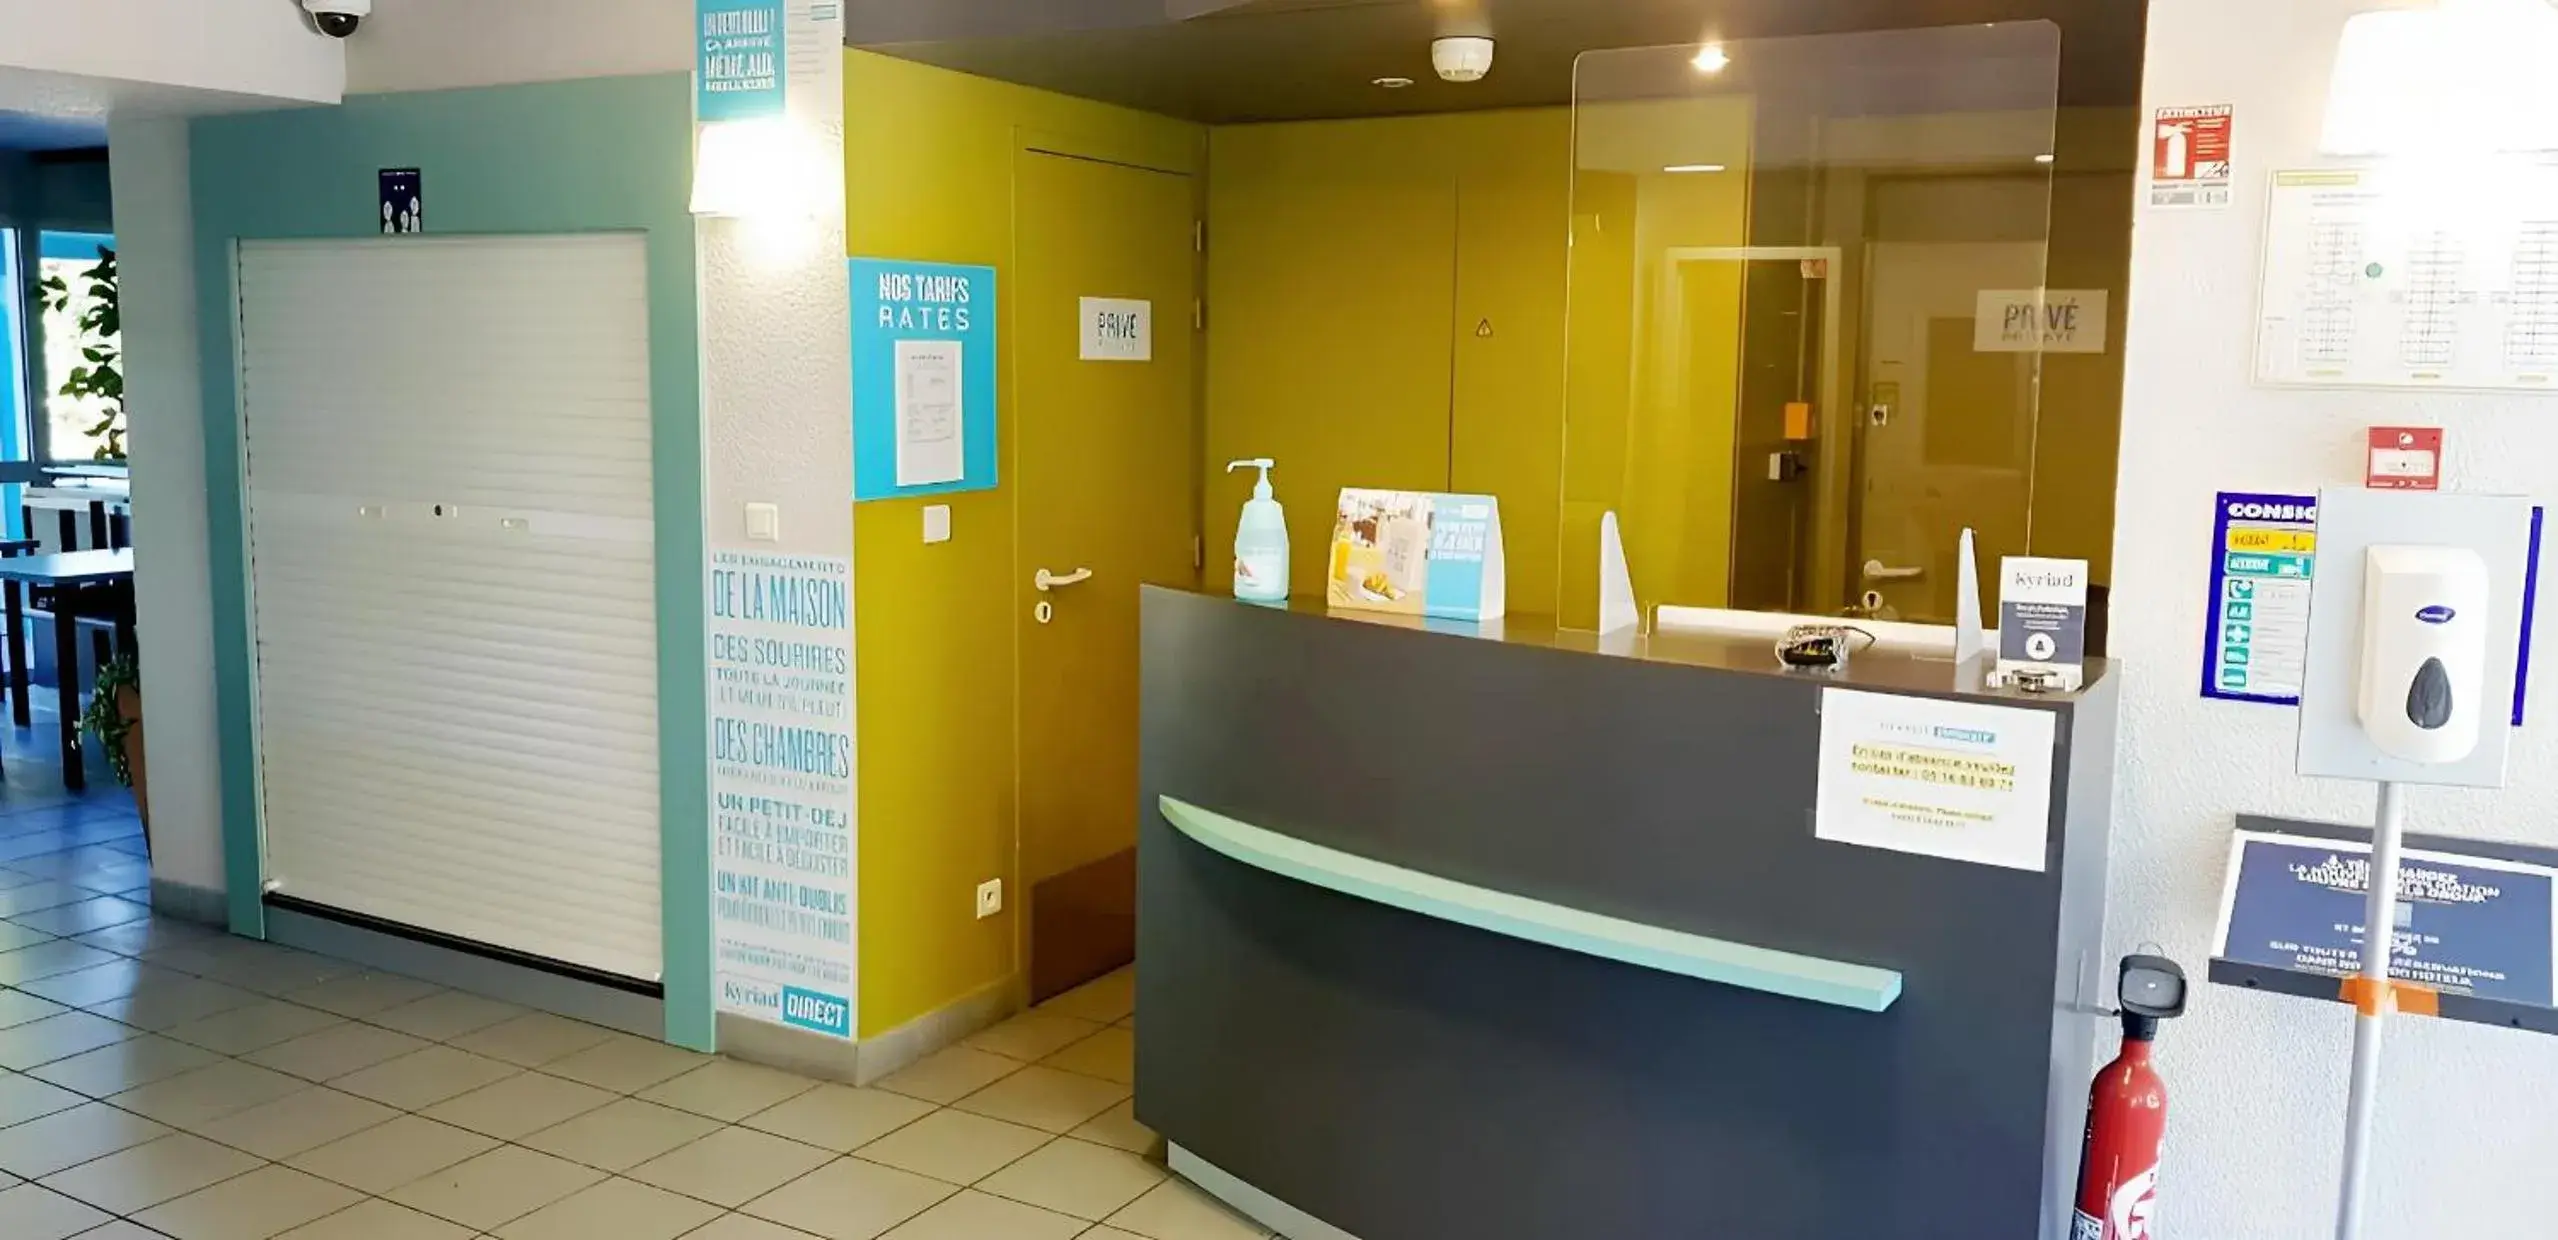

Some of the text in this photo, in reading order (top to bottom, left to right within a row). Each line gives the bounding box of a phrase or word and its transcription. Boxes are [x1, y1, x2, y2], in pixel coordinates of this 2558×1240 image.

[879, 272, 970, 304] NOS TARIFS
[878, 306, 970, 332] RATES
[2003, 296, 2080, 331] PRVÉ
[2015, 571, 2074, 591] Kyriad
[712, 568, 846, 631] DE LA MAISON
[713, 633, 846, 675] DES SOURIRES
[714, 716, 748, 763] DES
[753, 721, 849, 780] CHAMBRES
[718, 792, 743, 812] UN
[725, 980, 845, 1029] Kyriad DIRECT
